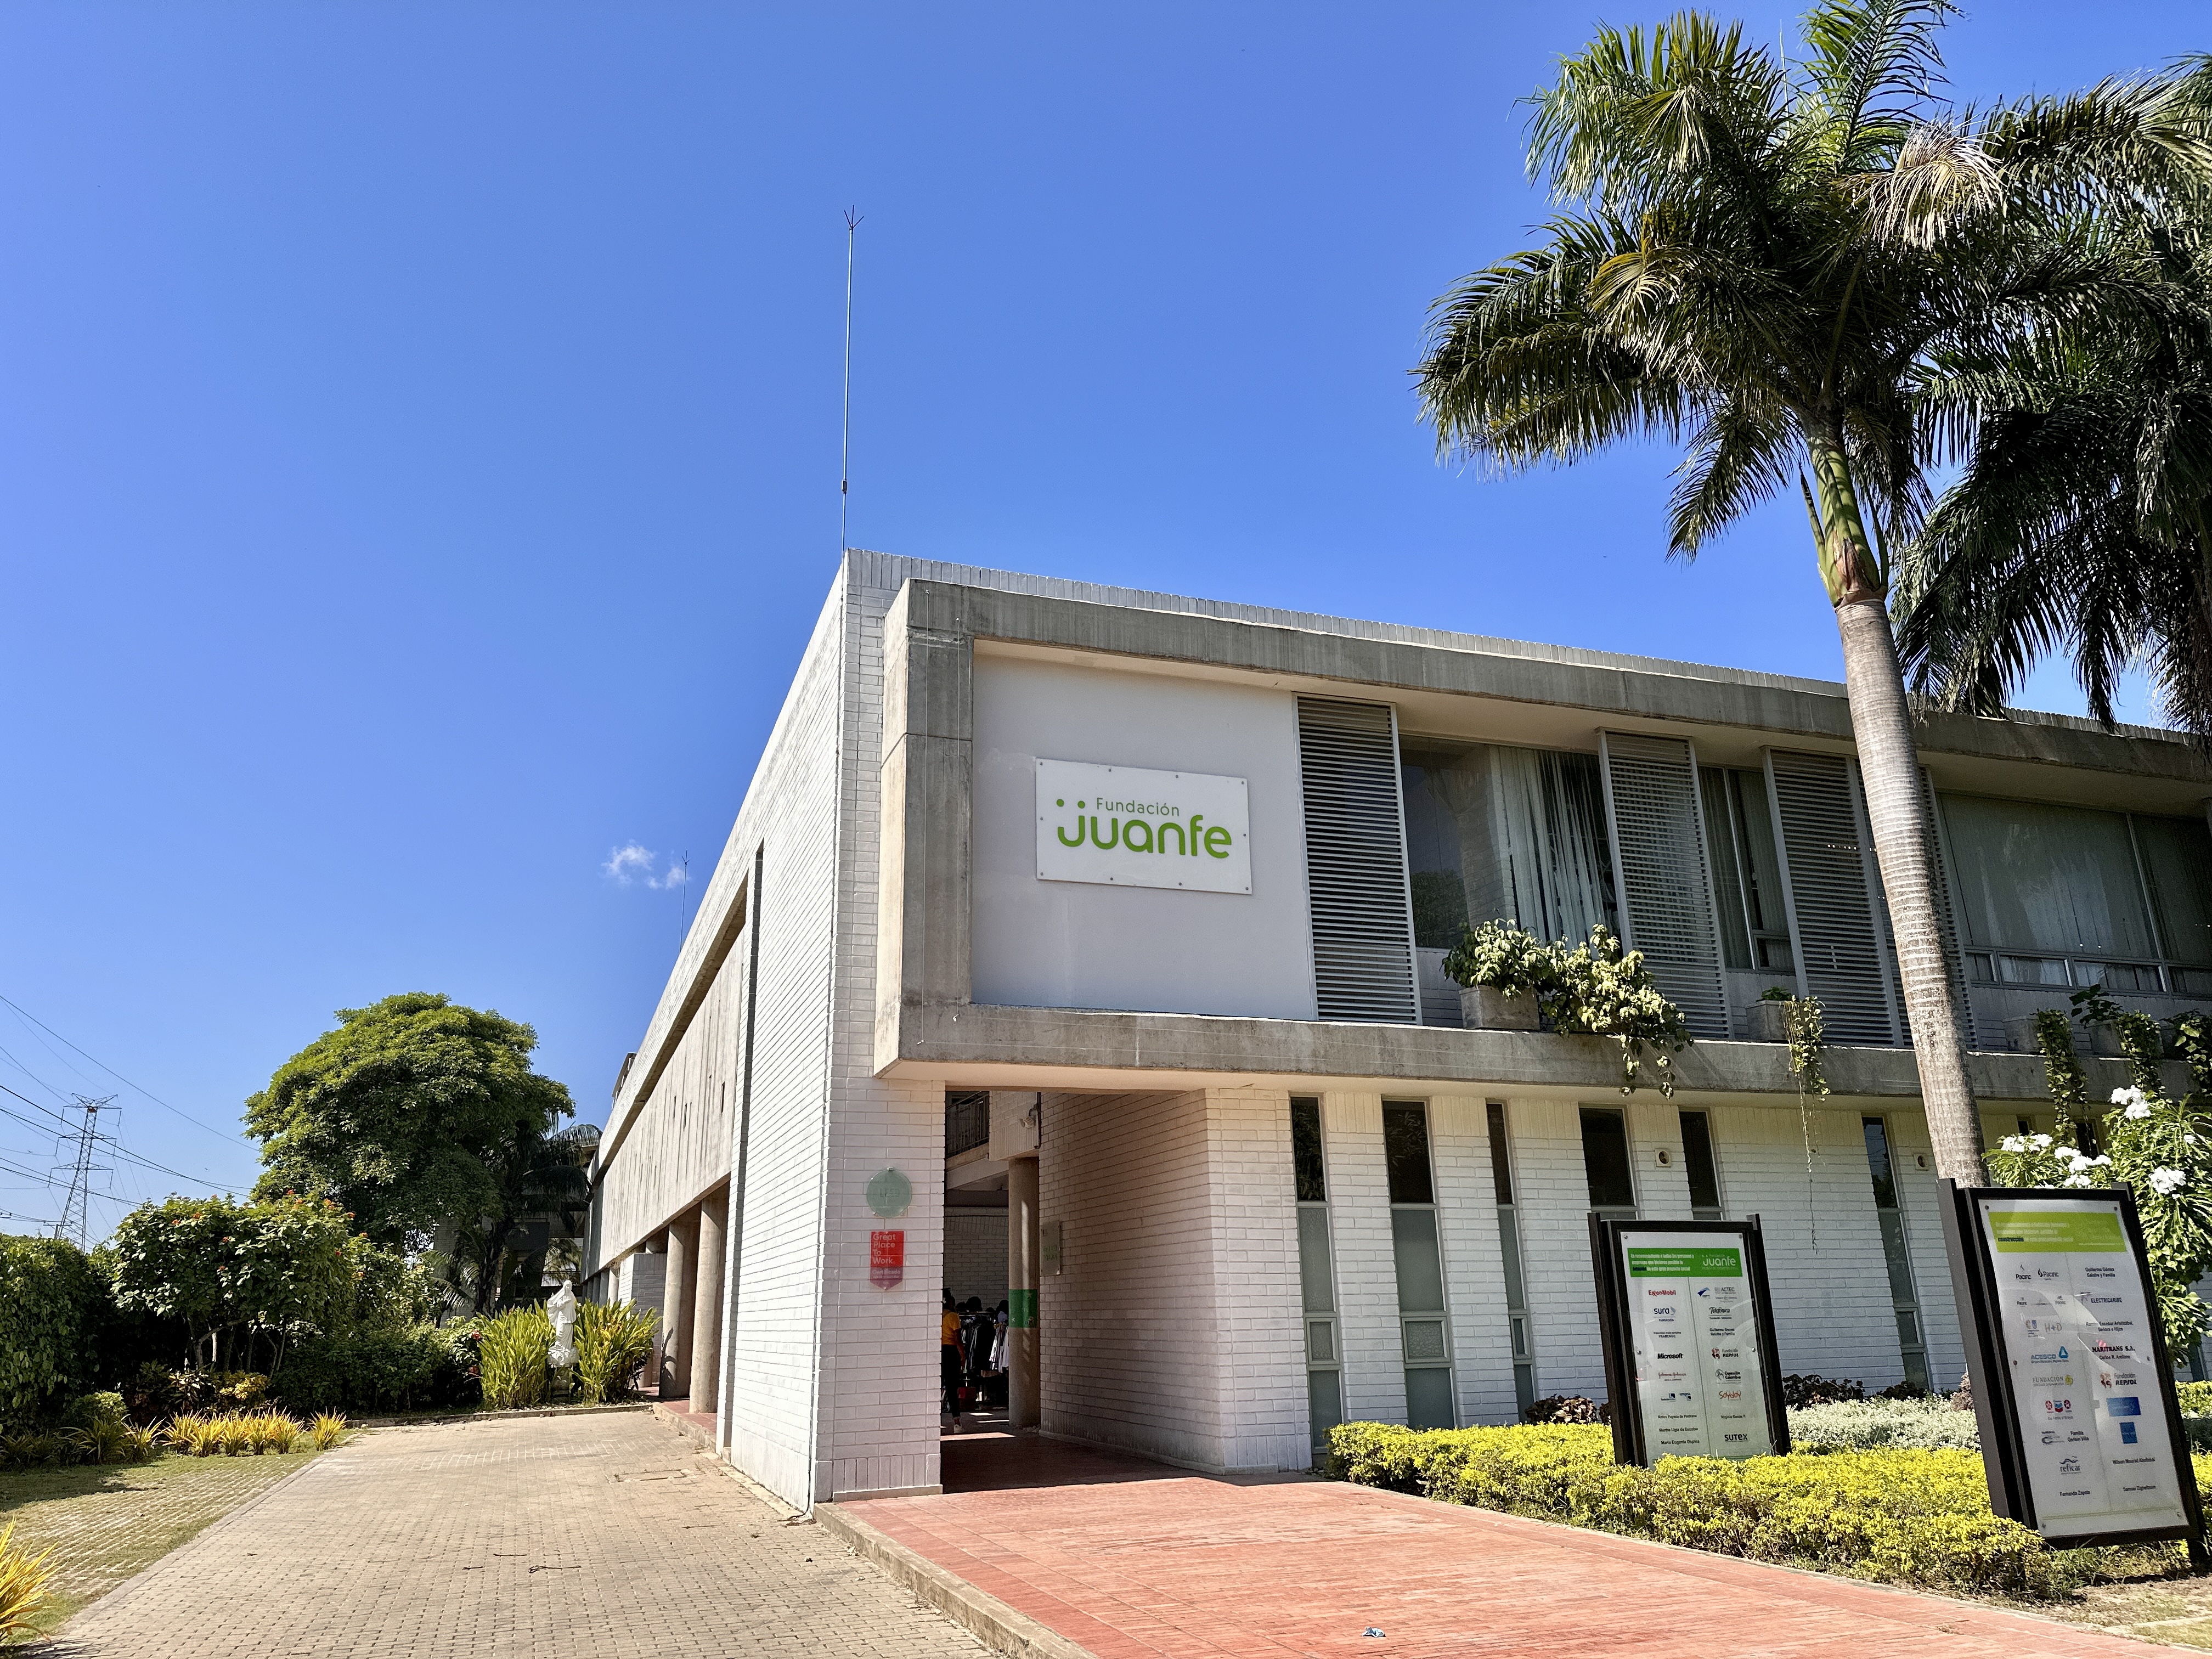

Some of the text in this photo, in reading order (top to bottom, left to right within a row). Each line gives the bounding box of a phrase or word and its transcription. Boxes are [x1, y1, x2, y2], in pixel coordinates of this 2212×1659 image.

[1097, 797, 1180, 817] Fundación
[1056, 799, 1232, 859] juanfe
[1702, 1255, 1736, 1266] juanfe
[2060, 1464, 2080, 1472] reficar
